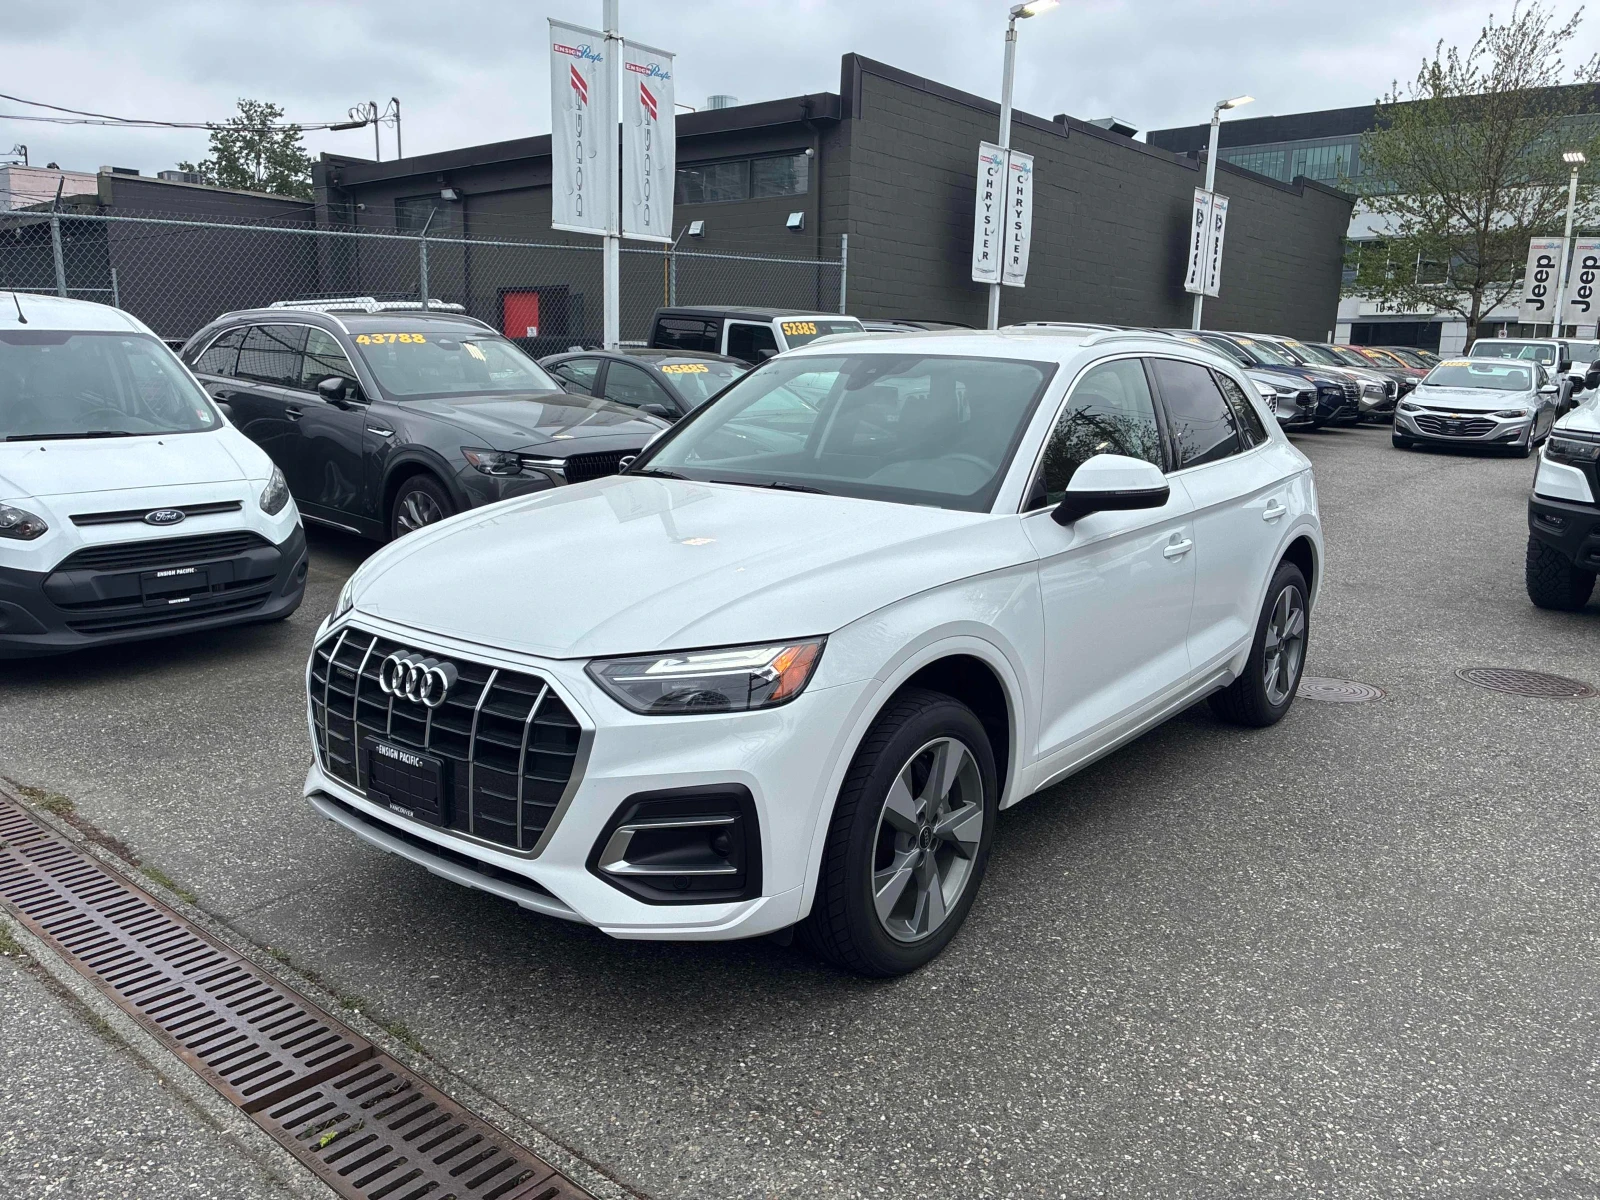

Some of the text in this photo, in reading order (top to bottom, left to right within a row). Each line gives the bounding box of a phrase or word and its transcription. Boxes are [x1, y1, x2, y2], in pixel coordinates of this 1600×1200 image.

[554, 44, 604, 63] ENSIGN Pacific
[626, 63, 671, 80] ENSIGN Pacific
[982, 167, 994, 260] CHRYSLER
[1013, 175, 1024, 265] CHRYSLER
[1525, 254, 1556, 311] Jeep
[1570, 255, 1600, 313] Jeep
[782, 322, 817, 336] 52385
[356, 333, 426, 345] 43788
[155, 511, 177, 521] Ford
[176, 567, 195, 575] PACIFIC
[378, 744, 420, 767] ENSIGN PACIFIC
[389, 803, 414, 818] VANCOUVER
